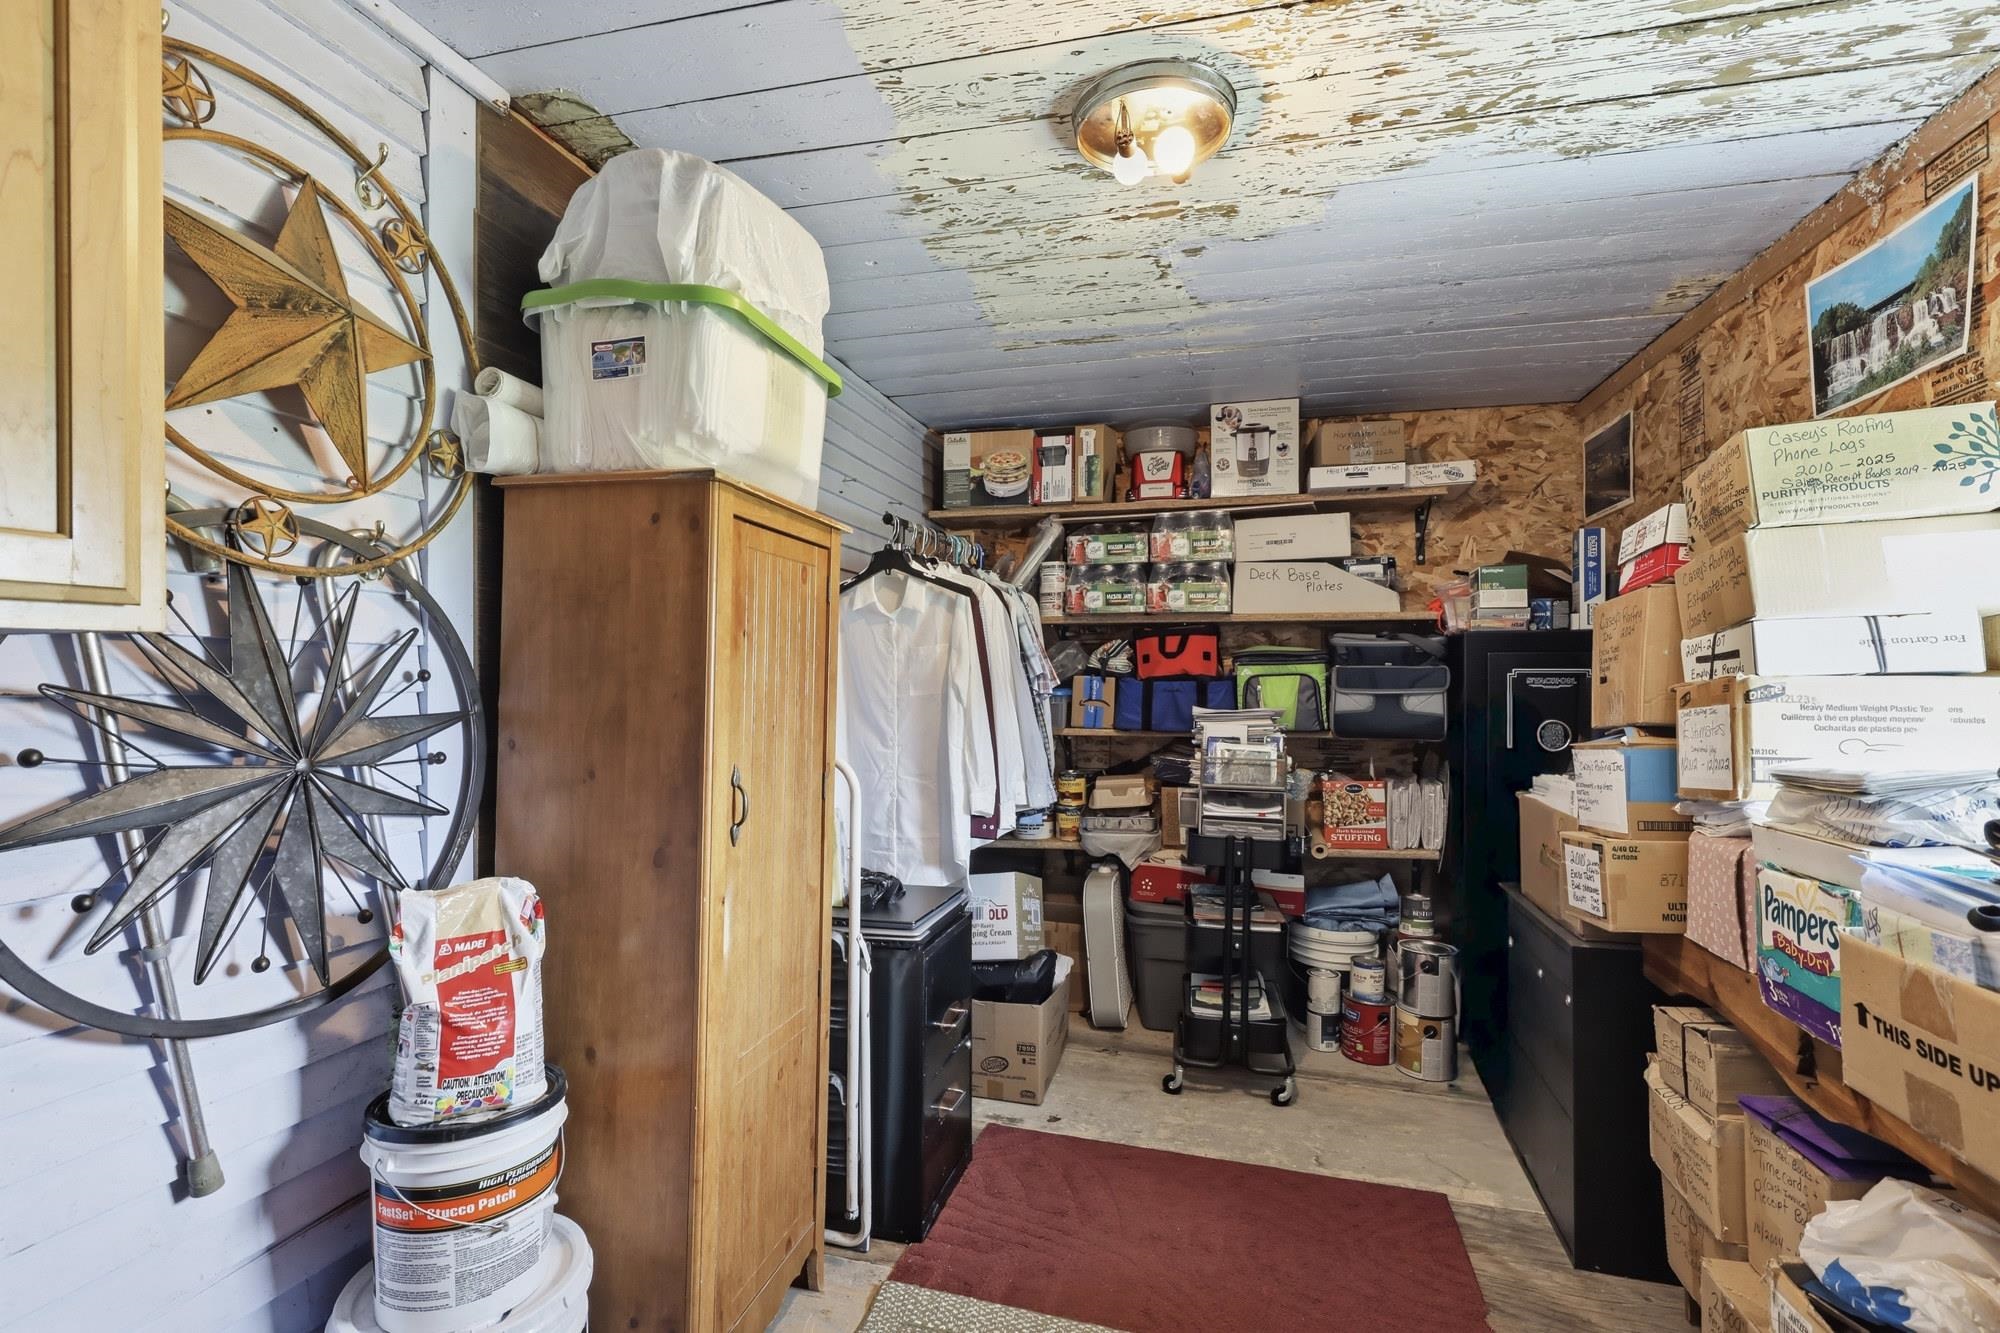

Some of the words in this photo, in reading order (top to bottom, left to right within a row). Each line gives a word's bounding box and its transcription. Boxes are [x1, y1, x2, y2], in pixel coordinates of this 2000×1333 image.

[1768, 425, 1828, 447] Casey's
[1837, 417, 1894, 438] Roofing
[1772, 448, 1822, 467] Phone
[1829, 437, 1866, 456] Logs
[1795, 461, 1834, 478] 2010
[1856, 453, 1896, 468] 2025
[1895, 466, 1920, 475] 2019
[1932, 461, 1967, 473] 2025
[1762, 488, 1808, 501] PURITY
[1822, 479, 1891, 493] PRODUCTS
[1249, 568, 1281, 580] Deck
[1287, 567, 1321, 582] Base
[1306, 581, 1344, 592] Plates
[1891, 635, 1938, 645] Carton
[1943, 634, 1967, 643] For
[1800, 703, 1825, 714] Heavy
[1825, 703, 1858, 713] Medium
[1860, 703, 1888, 715] Weight
[1890, 703, 1918, 713] Plastic
[1331, 833, 1382, 842] STUFFING
[1612, 853, 1638, 861] Cartons
[1765, 884, 1840, 951] Pampers
[989, 928, 1012, 937] Cream
[454, 939, 486, 951] MAPEI
[1776, 933, 1830, 977] Baby-Dry
[1872, 1015, 1911, 1050] THIS
[1916, 1038, 1963, 1077] SIDE
[1968, 1063, 2000, 1092] UP
[478, 1174, 504, 1190] HIGH
[426, 1203, 475, 1221] Stucco
[478, 1188, 517, 1211] Patch
